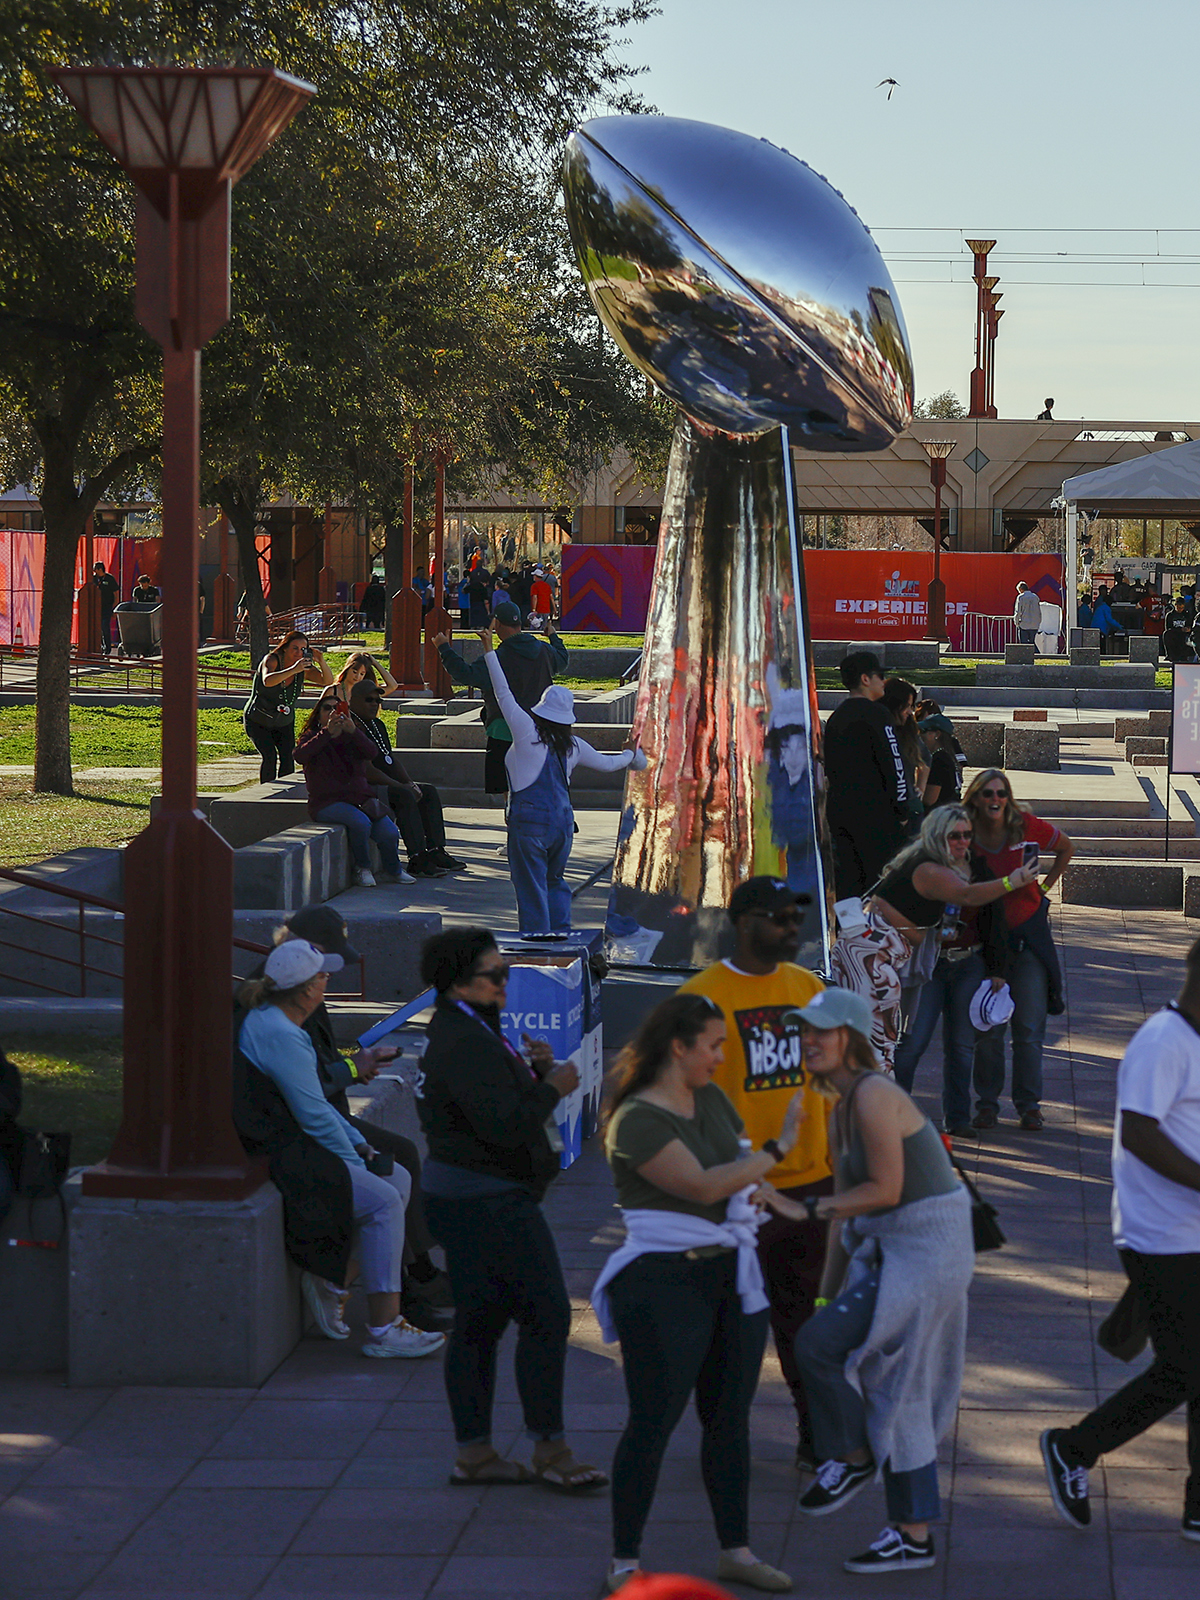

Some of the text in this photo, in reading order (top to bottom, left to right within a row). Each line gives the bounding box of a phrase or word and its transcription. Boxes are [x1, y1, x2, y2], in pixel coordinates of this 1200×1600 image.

[835, 599, 969, 615] EXPERIECE
[500, 1012, 561, 1030] CYCLE
[748, 1030, 801, 1076] HBCU
